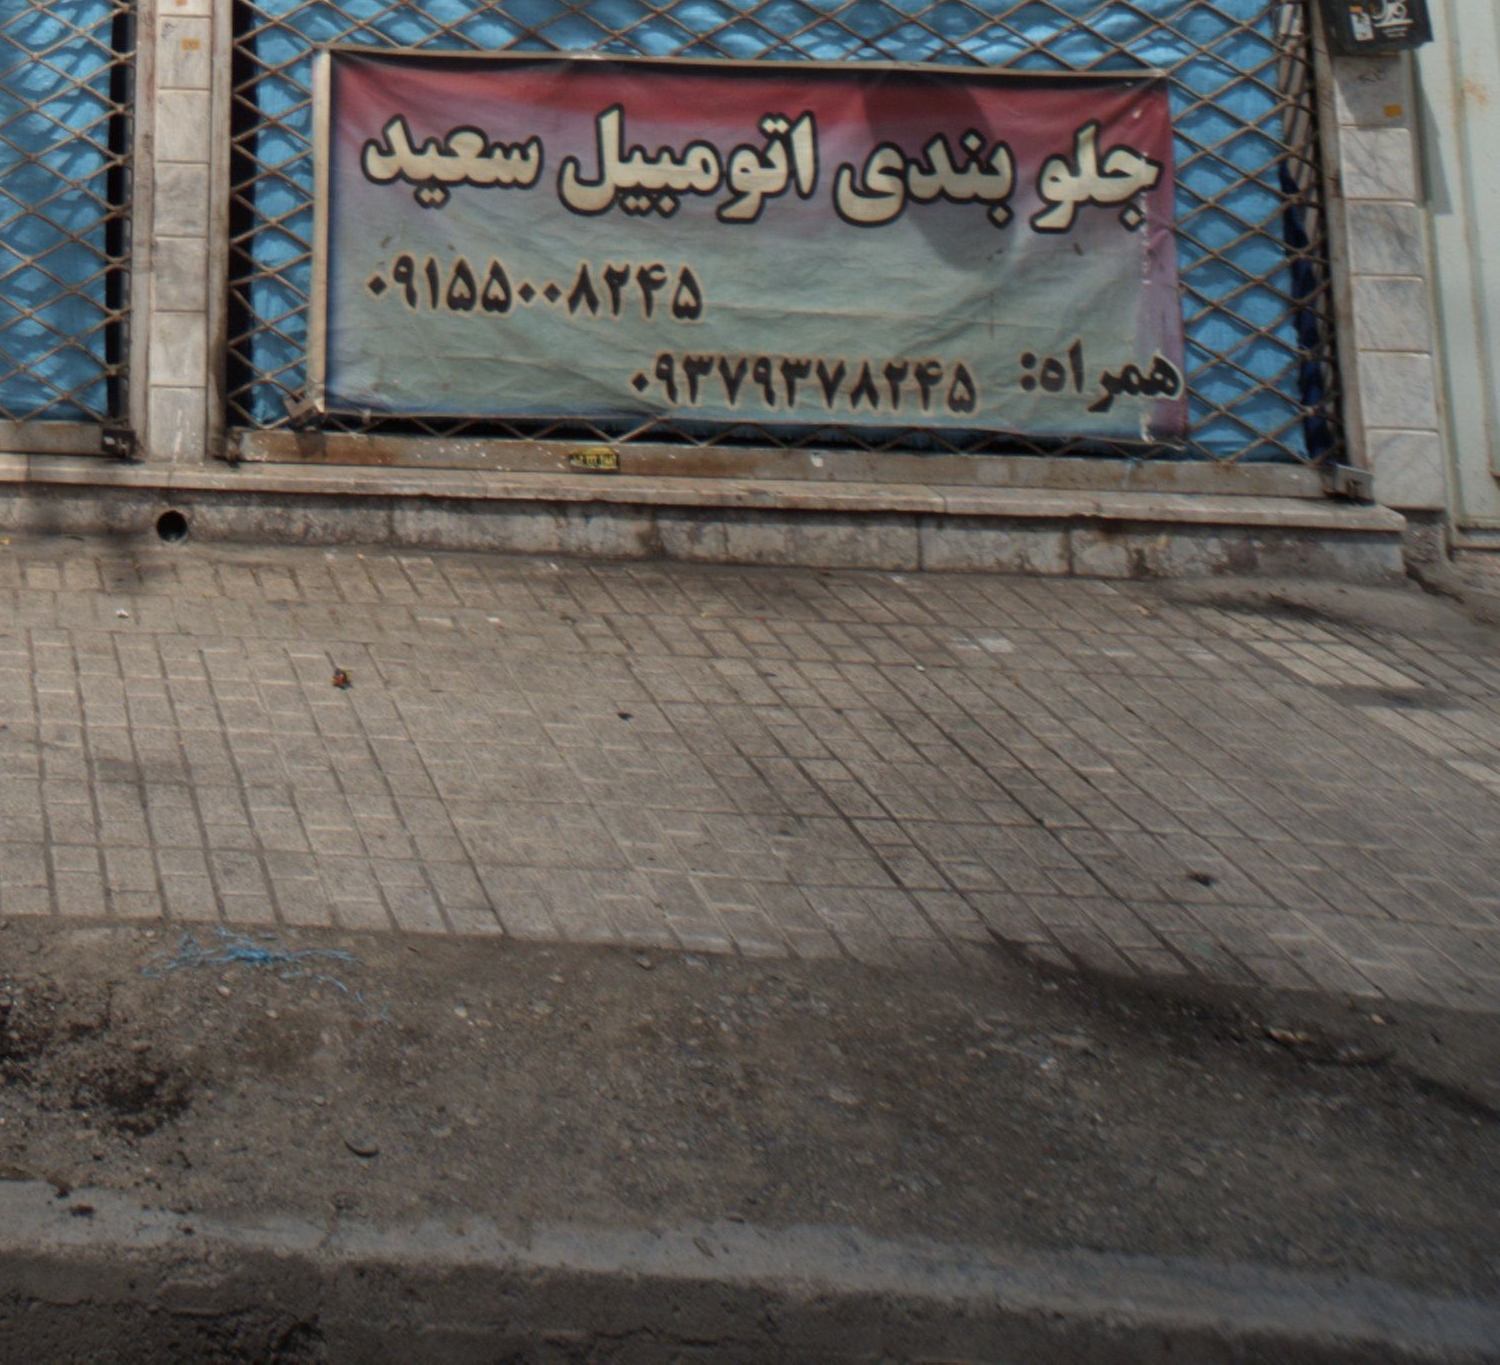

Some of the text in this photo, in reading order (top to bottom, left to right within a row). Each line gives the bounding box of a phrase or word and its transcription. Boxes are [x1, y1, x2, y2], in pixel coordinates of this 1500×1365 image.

[361, 103, 1162, 234] جلو بندی اتومبیل سعید
[367, 255, 703, 320] ۰۹۱۵۵۰۰۸۲۴۵
[632, 353, 976, 414] ۰۹۳۷۹۳۷۸۲۴۵
